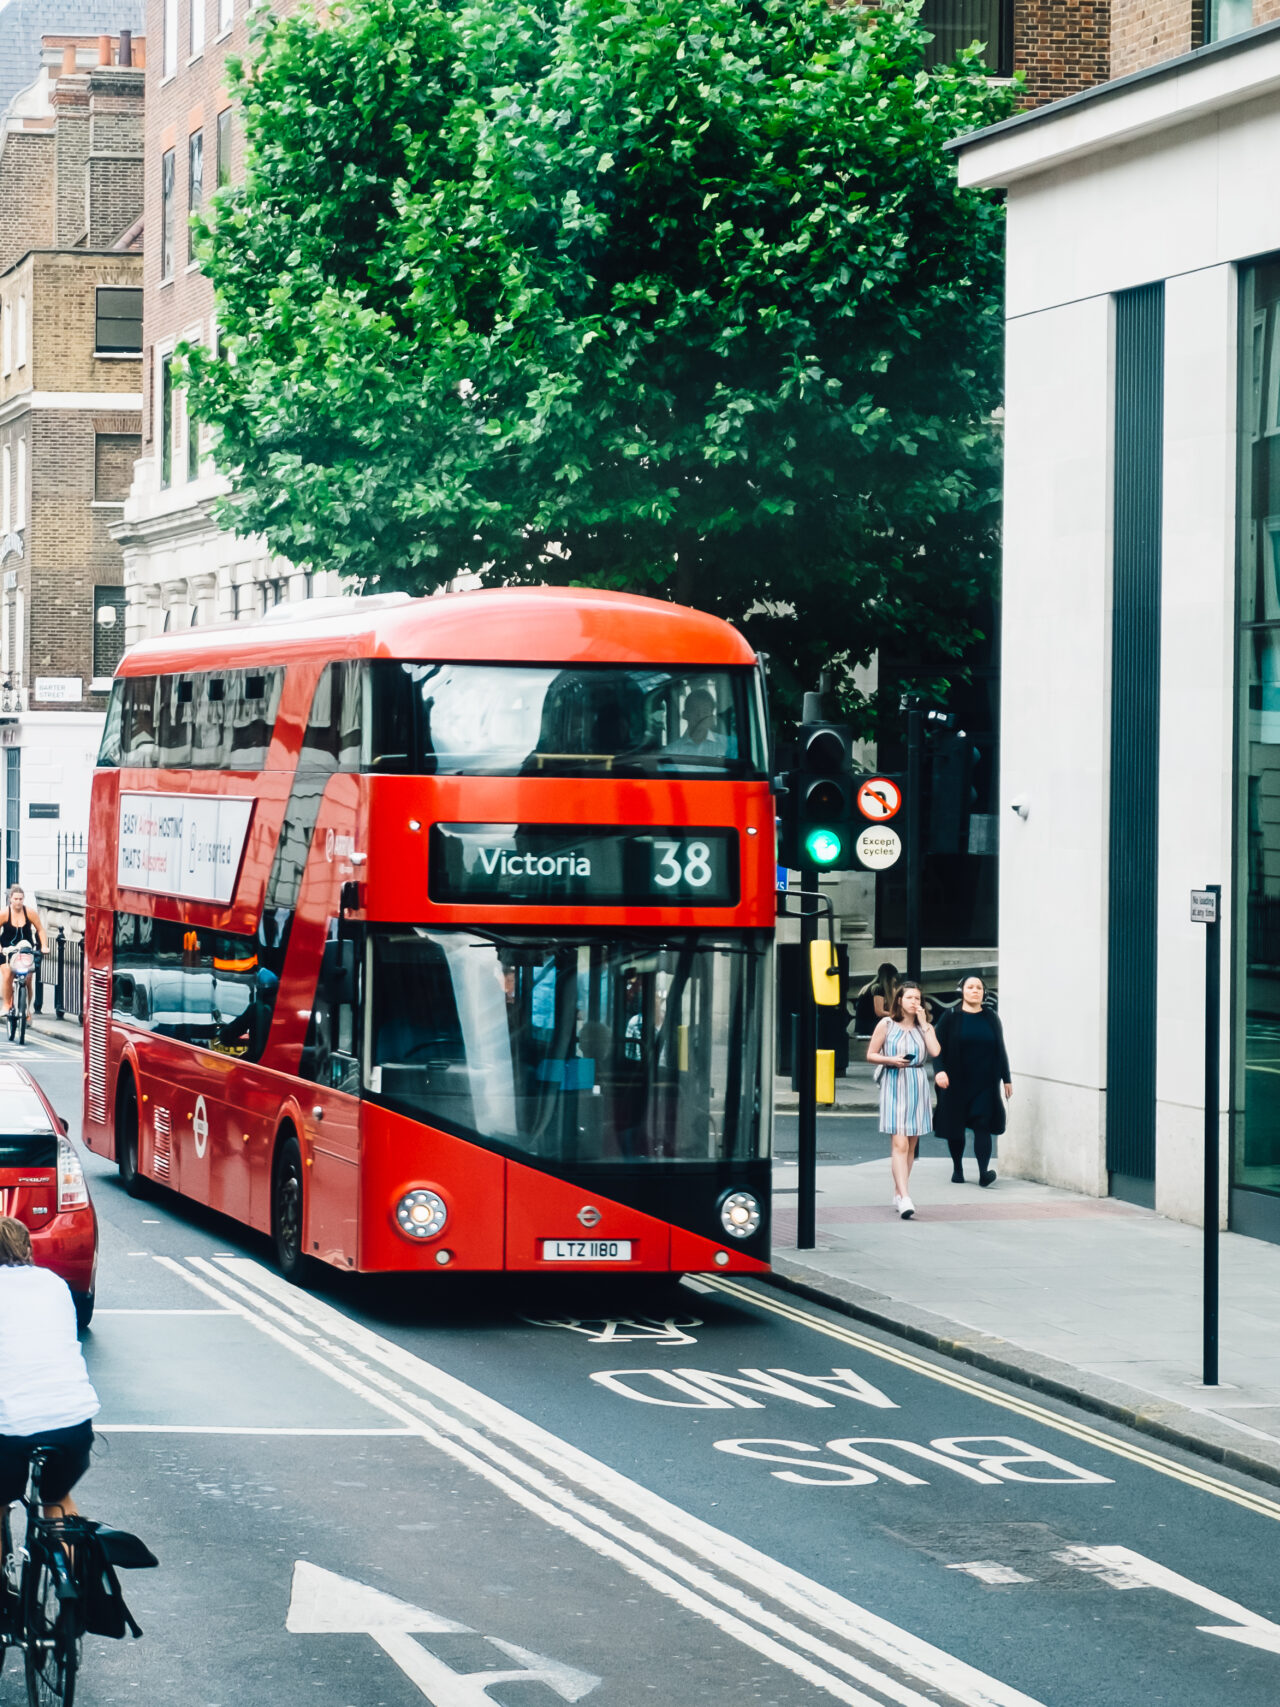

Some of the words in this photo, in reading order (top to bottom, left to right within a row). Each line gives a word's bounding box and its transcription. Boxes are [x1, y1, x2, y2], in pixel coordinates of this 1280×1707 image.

[123, 813, 137, 834] EASY
[862, 837, 895, 848] Except
[864, 848, 894, 856] cycles
[478, 847, 591, 876] Victoria
[653, 841, 713, 887] 38
[556, 1243, 586, 1257] LTZ
[590, 1243, 618, 1257] 1180
[588, 1368, 901, 1409] AND
[712, 1435, 1117, 1487] BUS
